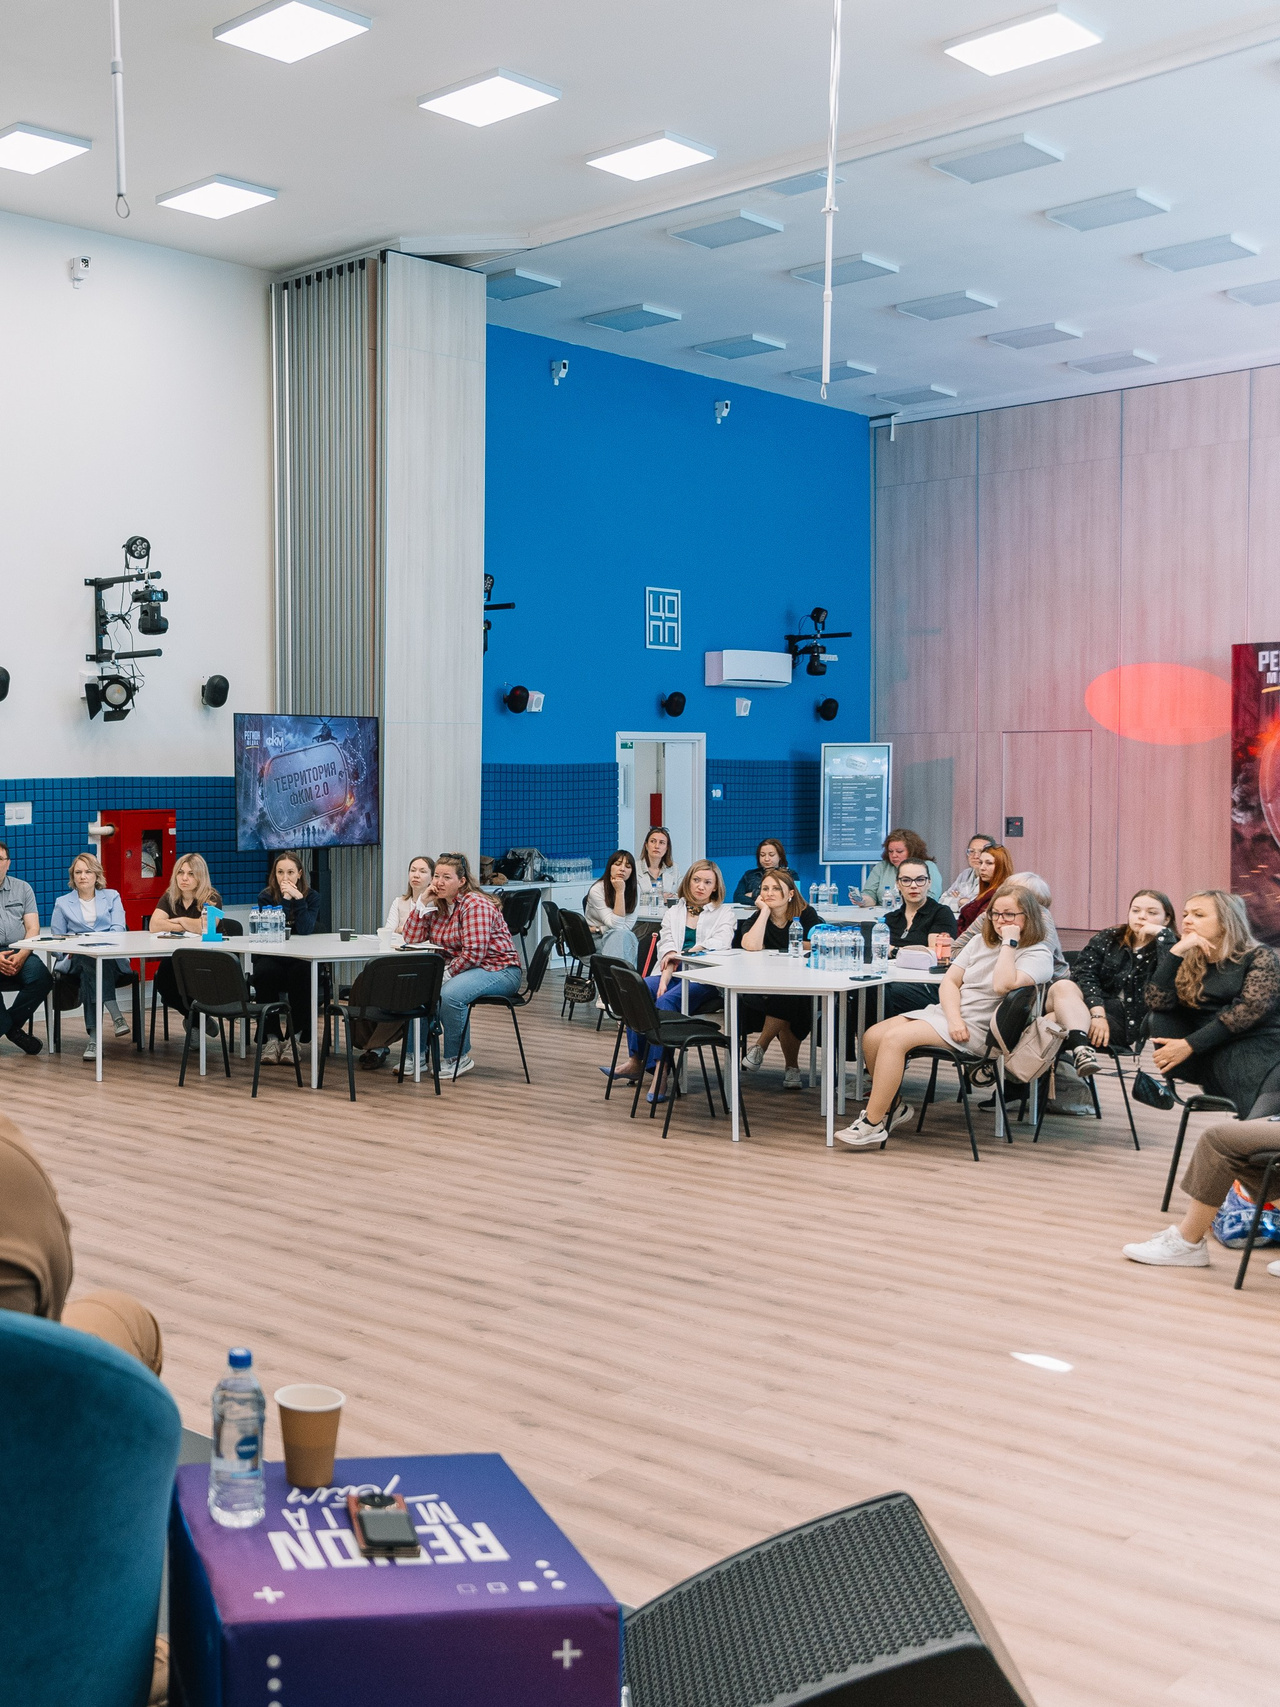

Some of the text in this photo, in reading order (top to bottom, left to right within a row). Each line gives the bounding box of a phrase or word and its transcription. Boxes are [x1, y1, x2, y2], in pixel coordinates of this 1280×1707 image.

[1258, 650, 1280, 672] РЕ
[1266, 671, 1280, 684] М
[273, 761, 338, 794] ТЕРРИТОРИЯ
[289, 781, 331, 808] ФКМ 2.0
[281, 1501, 460, 1532] MIA
[267, 1520, 512, 1571] REON
